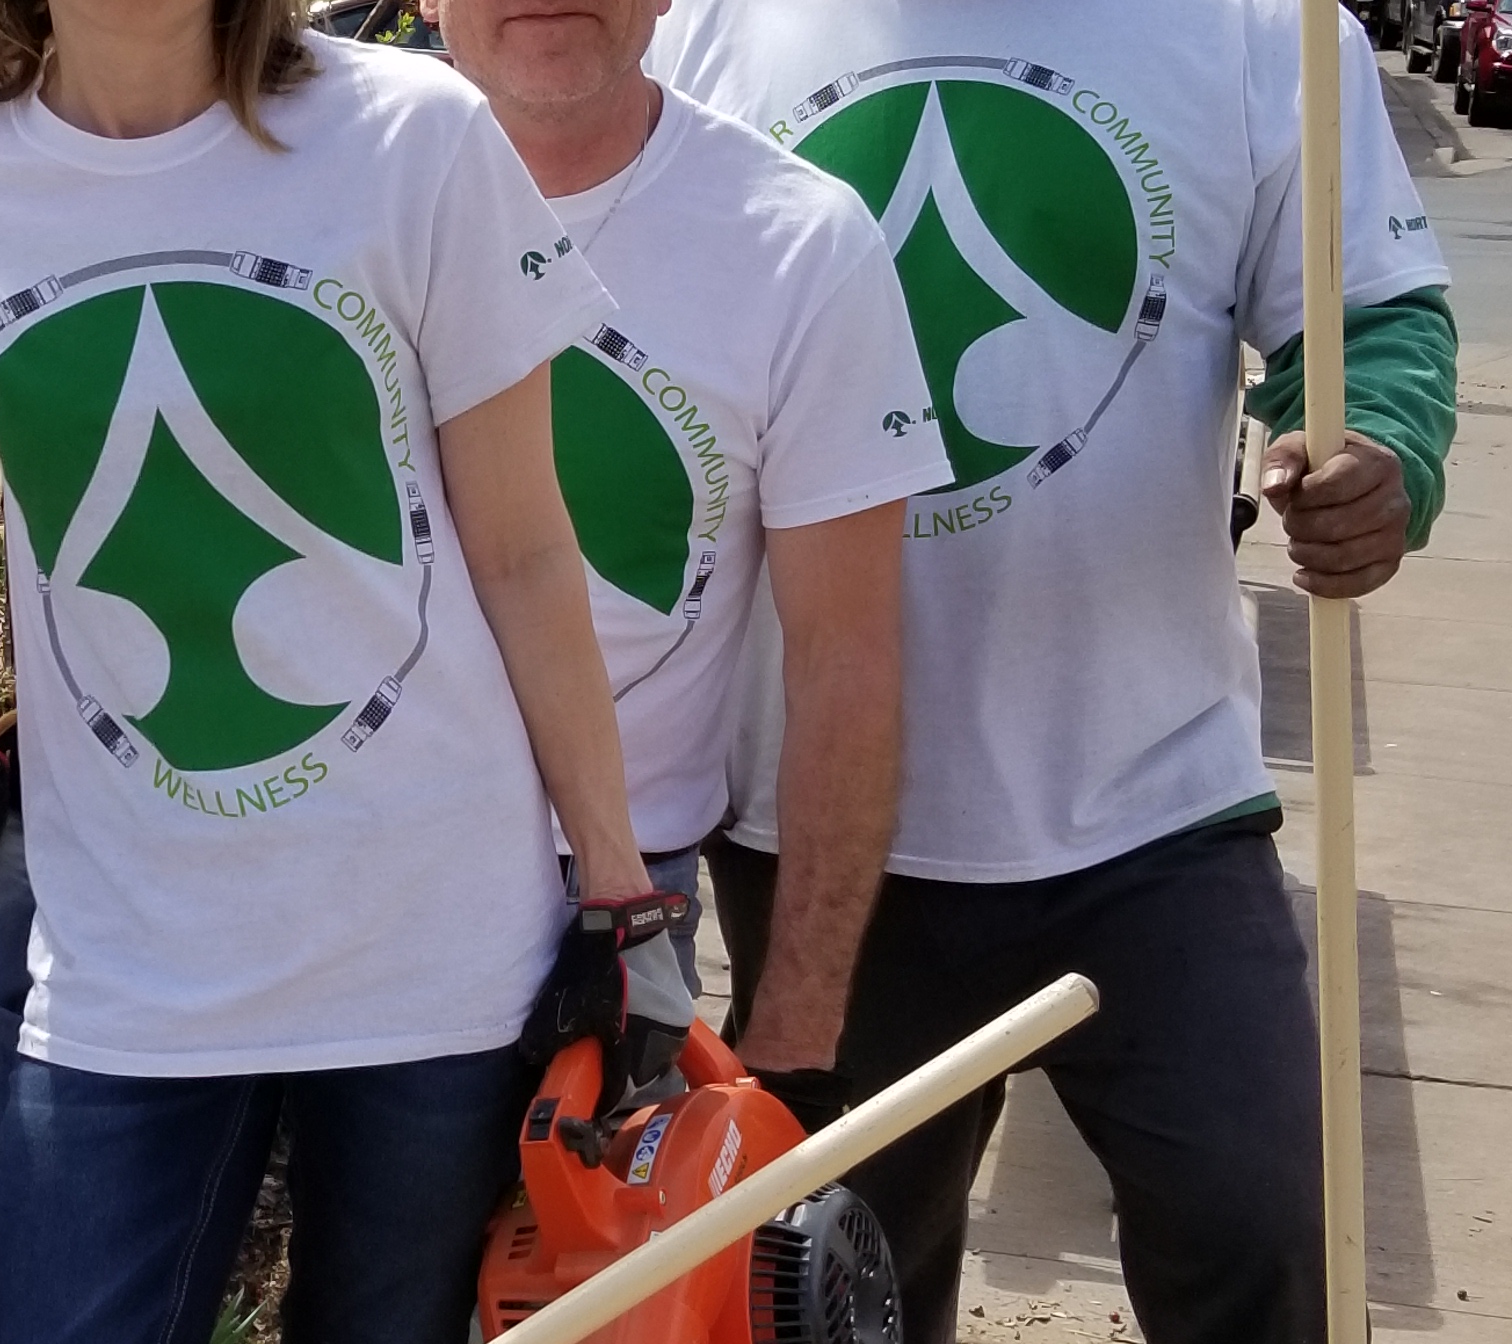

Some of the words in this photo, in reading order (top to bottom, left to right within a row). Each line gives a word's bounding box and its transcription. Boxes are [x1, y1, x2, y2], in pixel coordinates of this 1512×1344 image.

[1072, 88, 1176, 270] COMMUNITY
[312, 277, 416, 473] COMMUNITY
[641, 367, 731, 544] COMMUNITY
[151, 752, 330, 818] WELLNESS
[714, 1118, 742, 1190] ECHO
